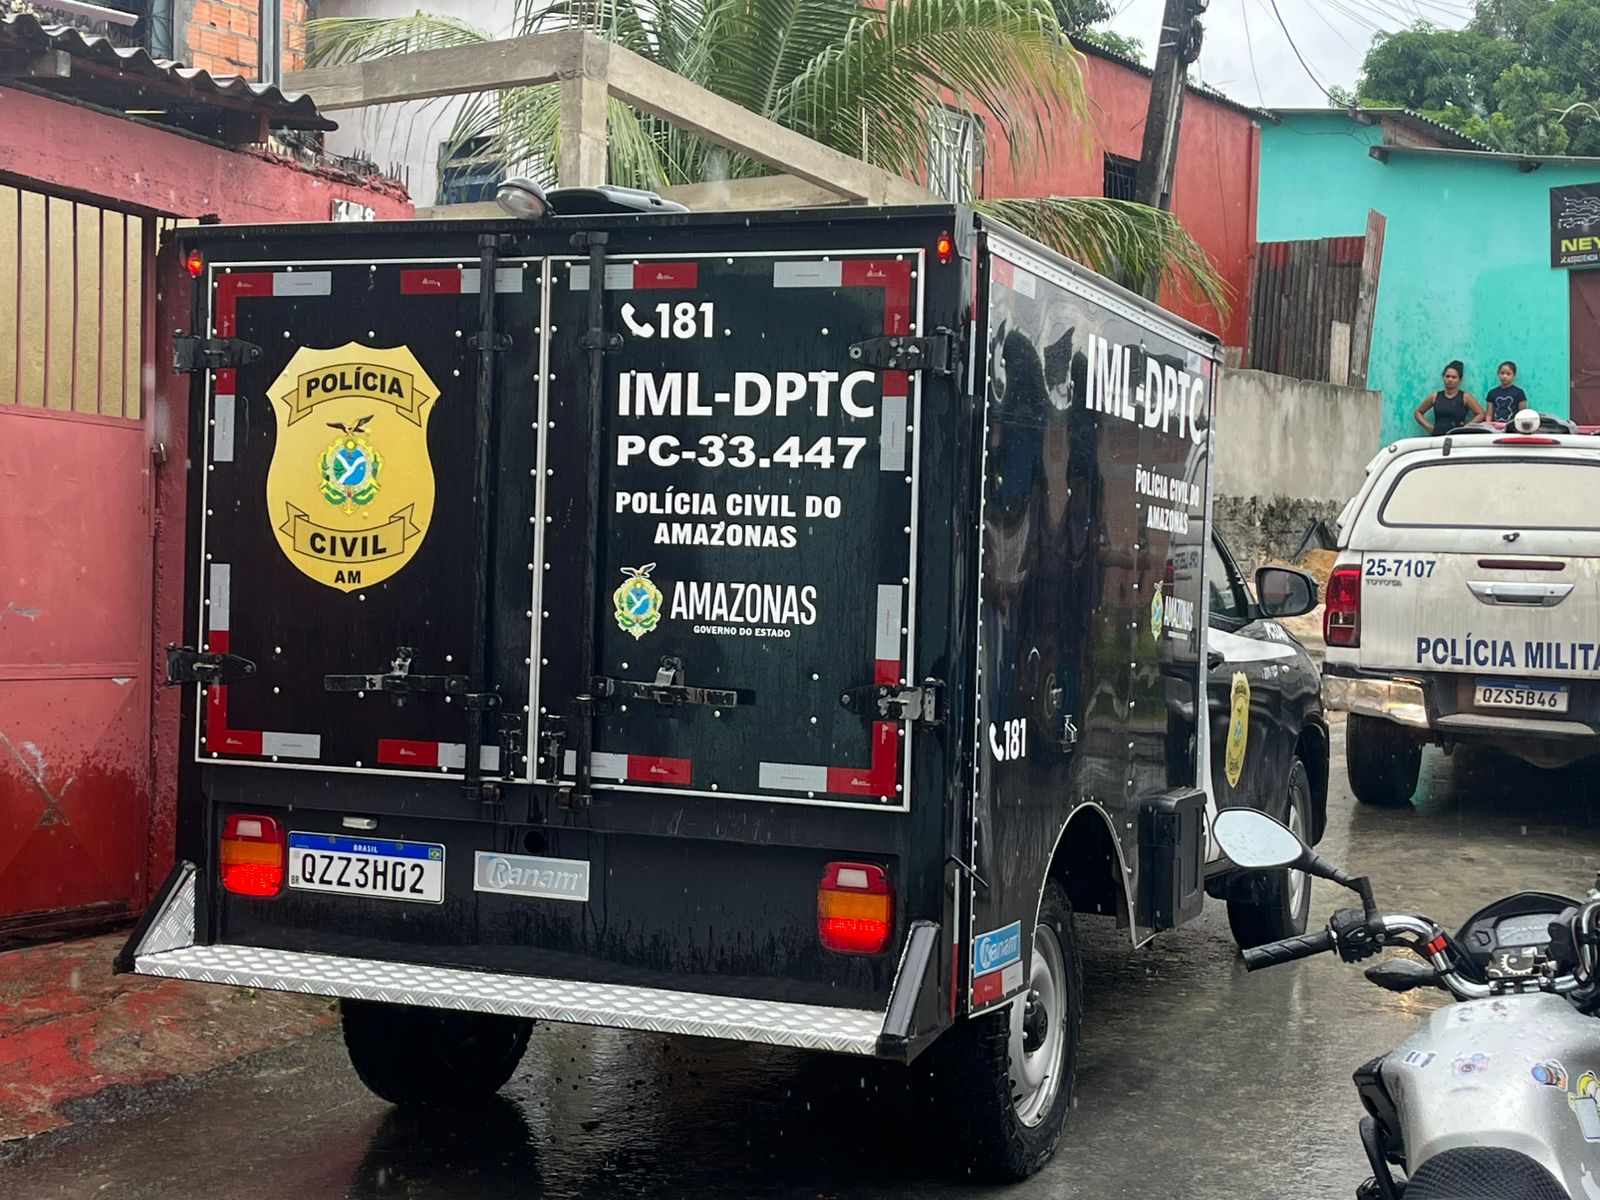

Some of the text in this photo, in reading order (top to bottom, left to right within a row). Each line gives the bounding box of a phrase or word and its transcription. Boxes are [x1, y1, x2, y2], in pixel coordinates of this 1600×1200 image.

[655, 302, 714, 339] 181
[306, 367, 404, 398] POLÍCIA
[618, 371, 875, 418] IML-DPTC
[1085, 334, 1204, 445] IML-DPTC
[616, 435, 867, 469] PC-33.447
[1135, 466, 1168, 500] POLÍCIA
[615, 486, 841, 519] POLÍCIA CIVIL DO
[654, 522, 797, 548] AMAZONAS
[1147, 504, 1188, 535] AMAZONAS
[309, 533, 387, 557] CIVIL
[334, 570, 361, 584] AM
[1365, 558, 1437, 578] 25-7107
[670, 581, 817, 626] AMAZONAS
[693, 625, 791, 638] GOVERNO DO ESTADO
[1416, 632, 1516, 668] POLÍCIA
[1483, 688, 1557, 707] QZS5B46
[1003, 718, 1026, 760] 181
[353, 844, 378, 853] BRASIL
[302, 853, 424, 894] QZZ3H02
